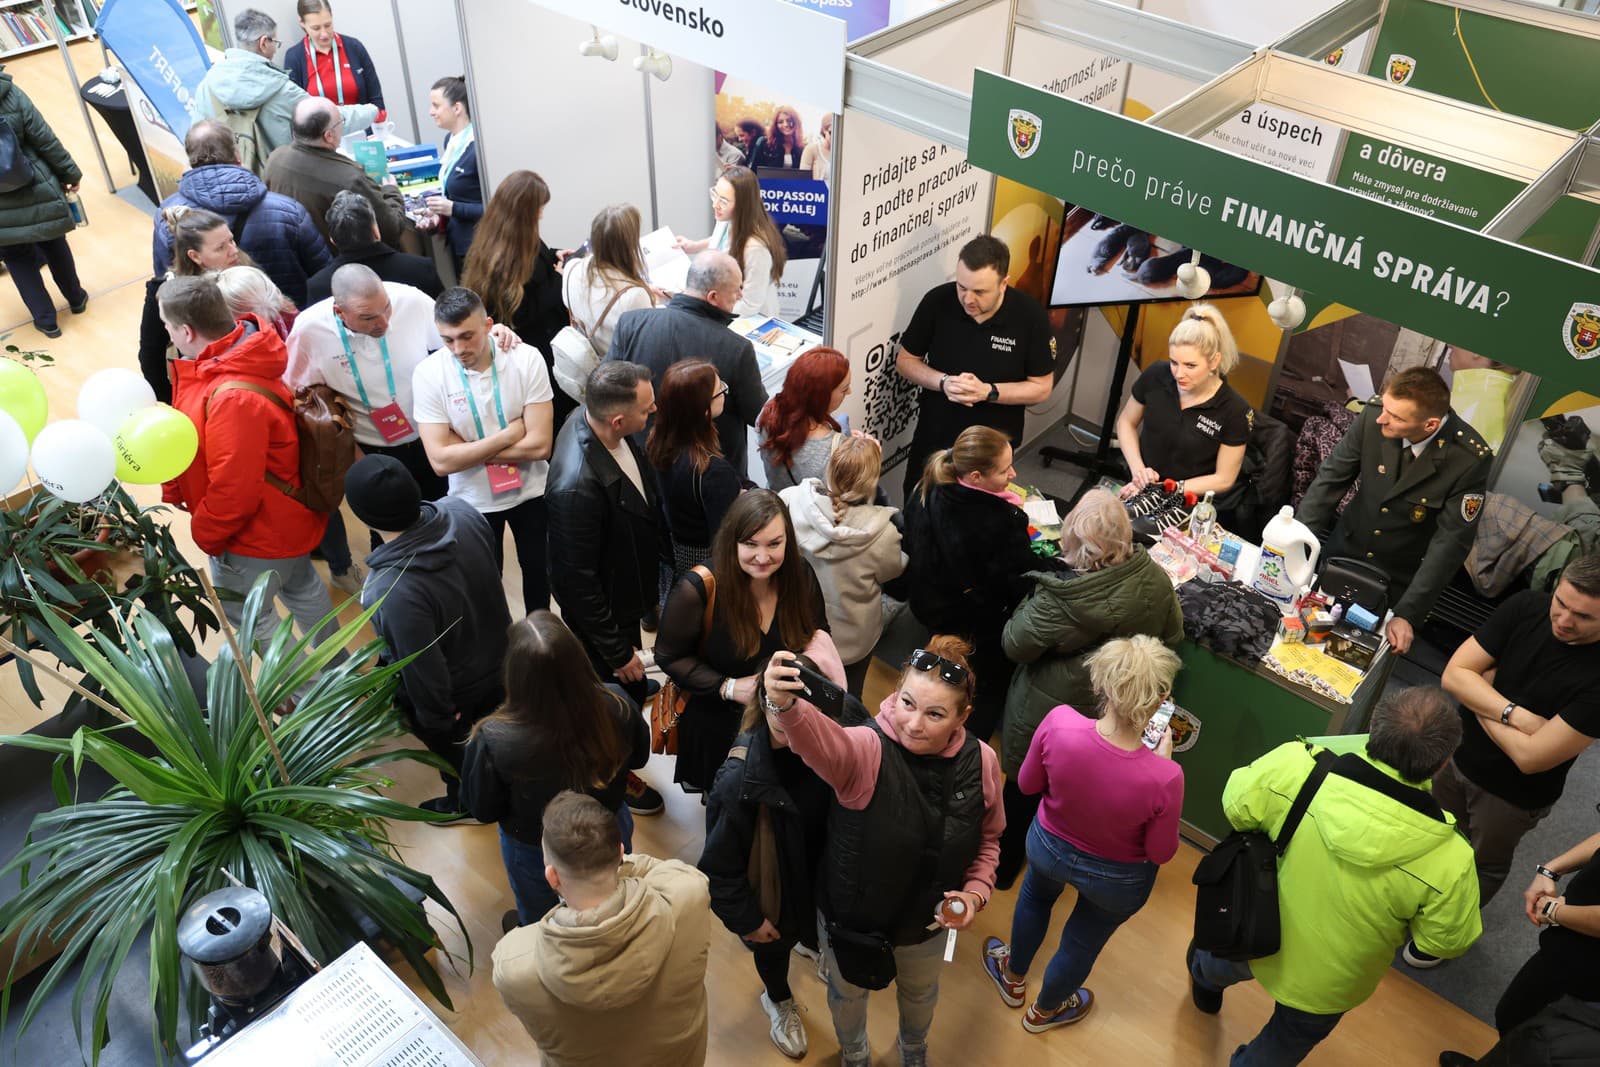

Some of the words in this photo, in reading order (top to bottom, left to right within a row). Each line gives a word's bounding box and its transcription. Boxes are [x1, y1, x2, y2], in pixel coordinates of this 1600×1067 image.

[619, 0, 725, 38] ovensko
[1079, 76, 1118, 104] slanie
[1241, 109, 1252, 124] a
[1257, 110, 1323, 146] úspech
[862, 155, 917, 196] Pridajte
[921, 145, 936, 166] sa
[1360, 143, 1372, 160] a
[1377, 145, 1447, 182] dôvera
[760, 189, 825, 203] ROPASSOM
[763, 202, 779, 212] OK
[782, 202, 817, 216] ĎALEJ
[862, 210, 871, 227] a
[917, 159, 972, 202] pracova
[1352, 170, 1373, 185] Máte
[1374, 179, 1404, 195] zmysel
[1404, 188, 1419, 201] pre
[1421, 192, 1479, 218] dodržiavanie
[851, 243, 867, 264] do
[873, 203, 934, 252] finančnej
[937, 182, 978, 216] správy
[1072, 149, 1136, 188] prečo
[1144, 175, 1212, 215] práve
[1221, 196, 1366, 270] FINANČNÁ
[1373, 250, 1511, 318] SPRÁVA?
